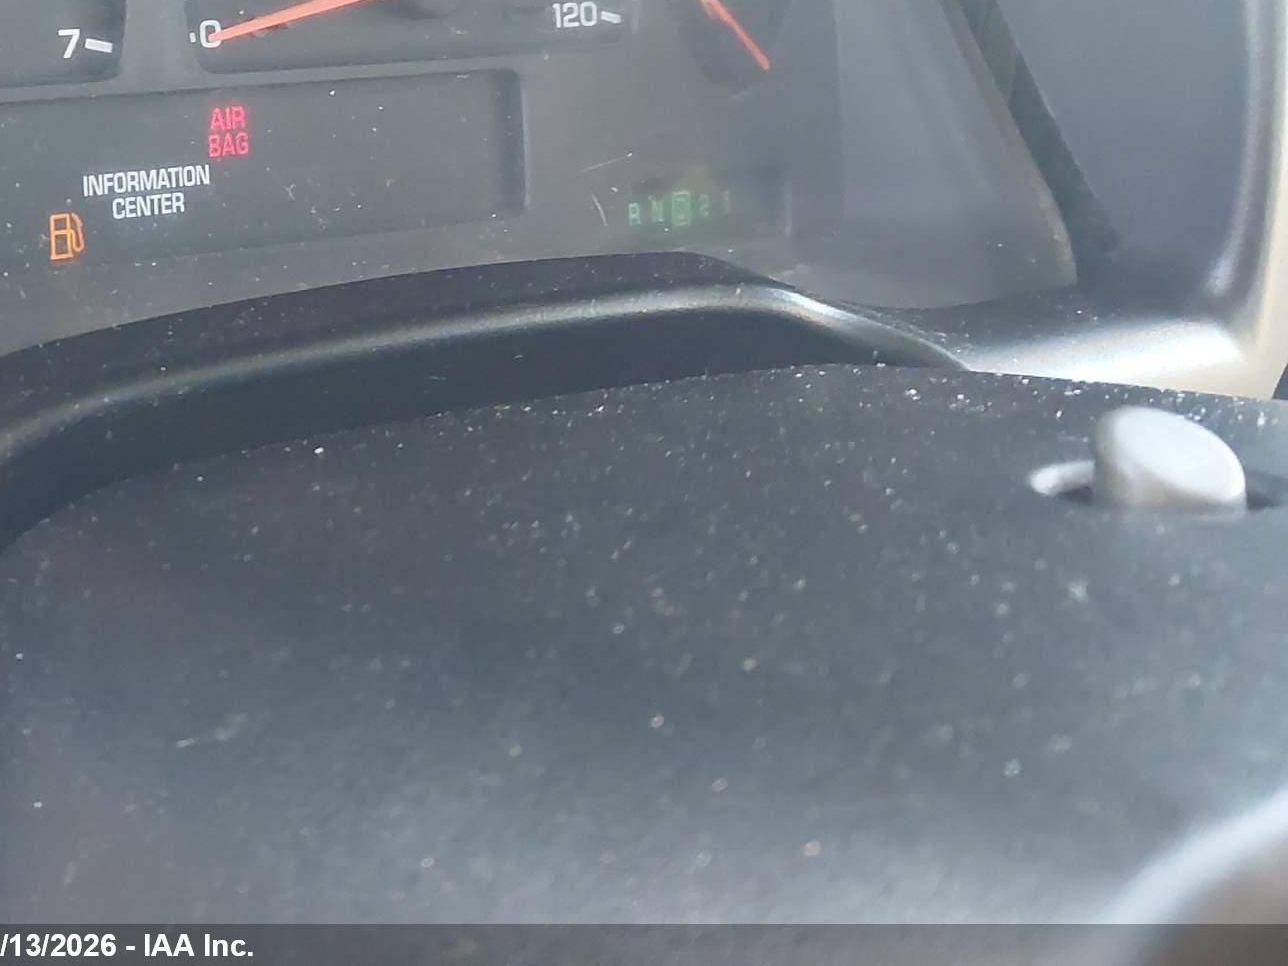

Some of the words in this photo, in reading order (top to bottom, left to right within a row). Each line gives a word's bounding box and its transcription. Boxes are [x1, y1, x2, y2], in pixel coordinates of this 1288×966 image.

[552, 2, 598, 28] 120
[57, 28, 81, 58] 7
[199, 19, 223, 48] 0
[210, 106, 247, 131] AIR
[208, 132, 249, 158] BAG
[82, 164, 211, 198] INFORMATION
[112, 192, 185, 219] CENTER
